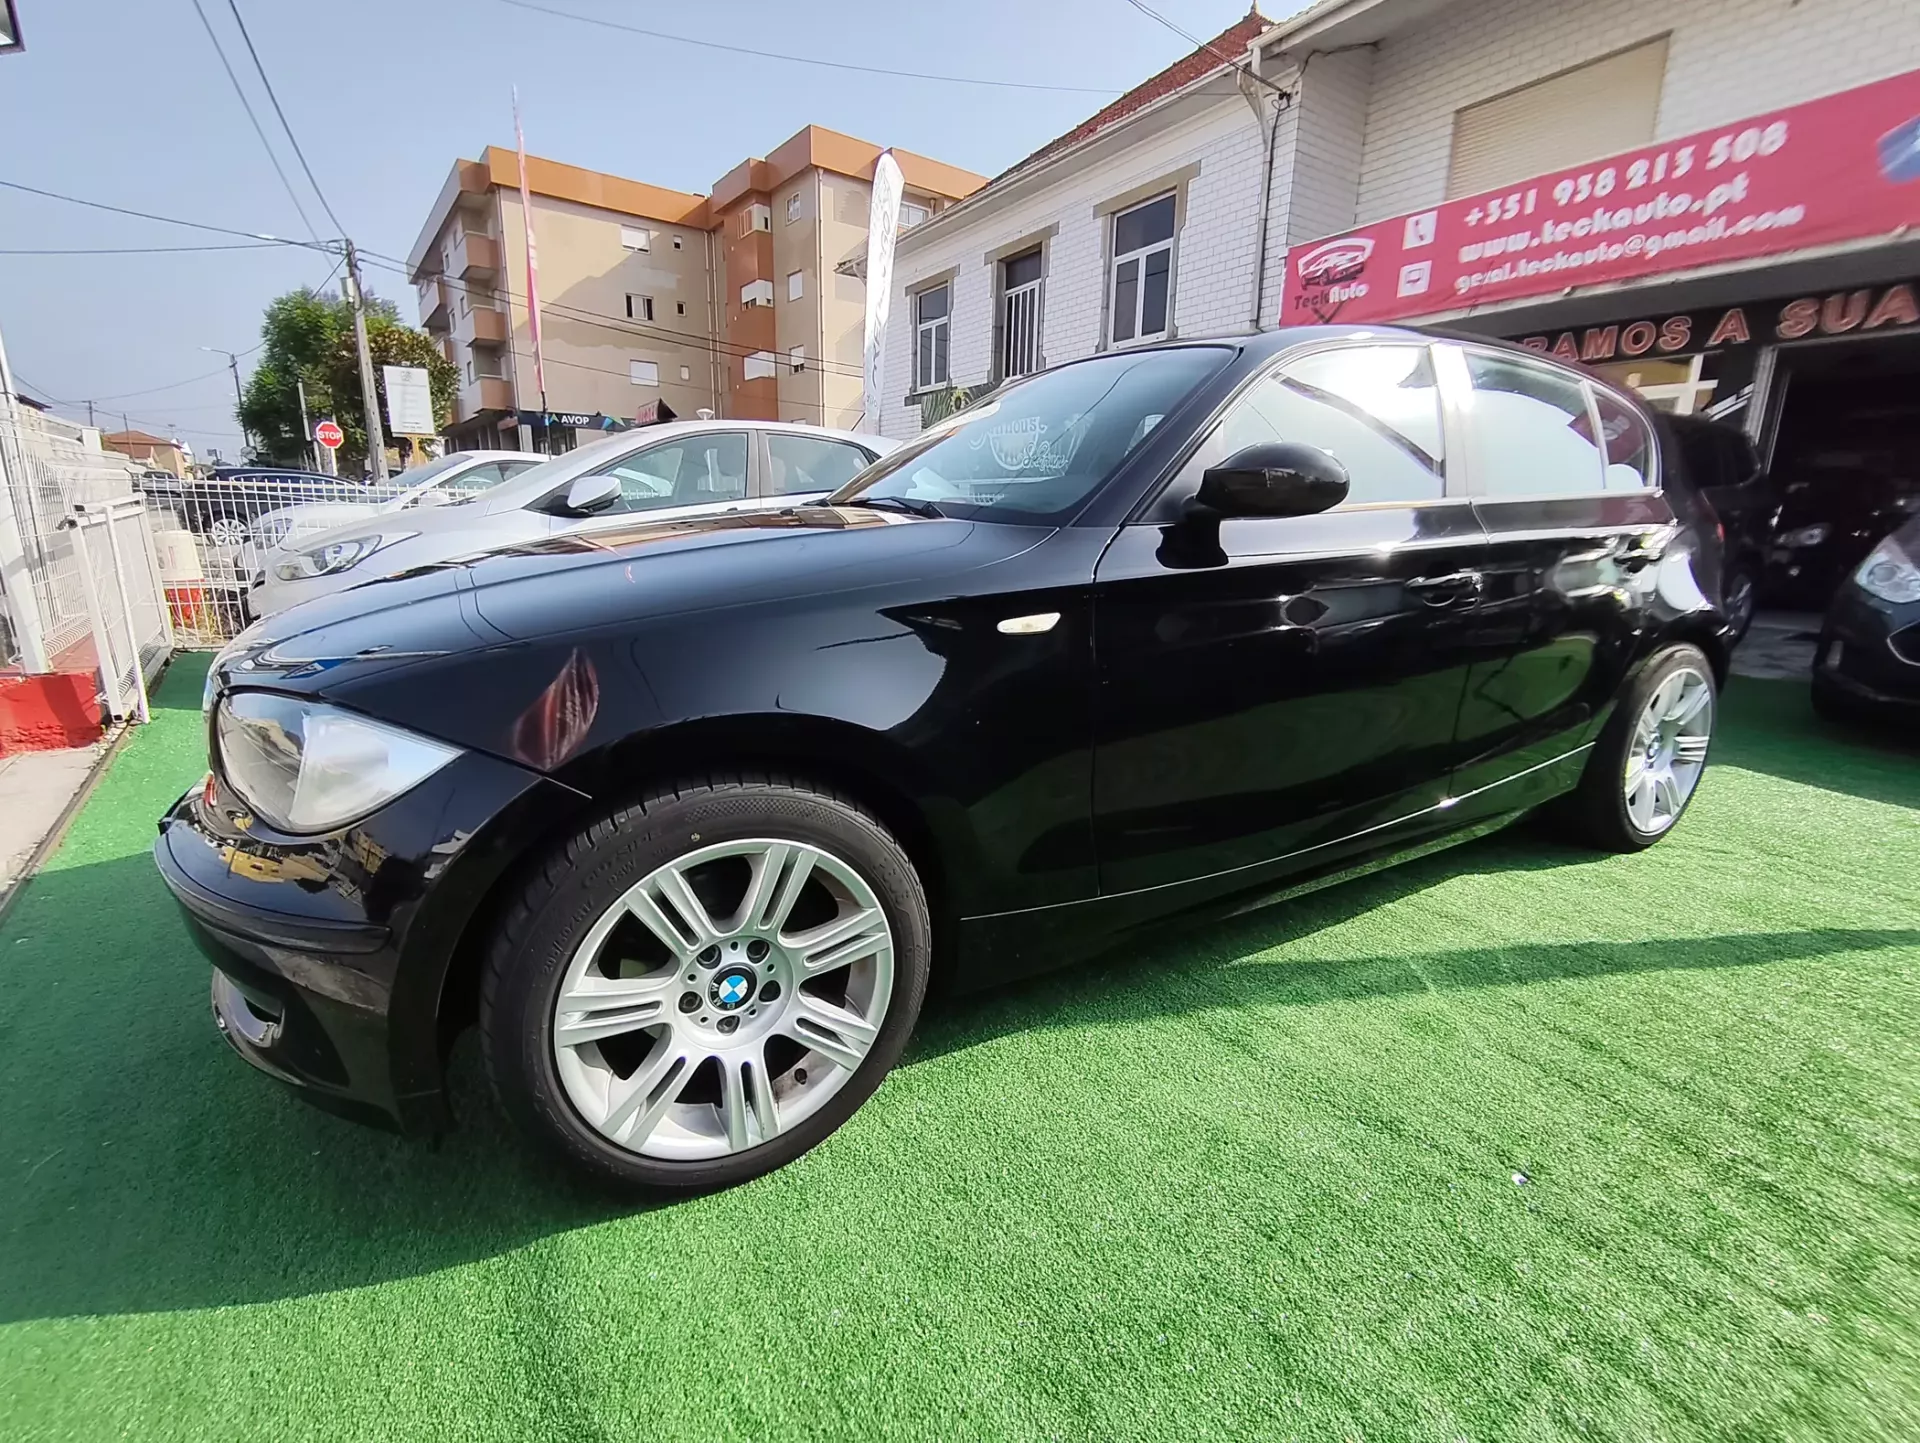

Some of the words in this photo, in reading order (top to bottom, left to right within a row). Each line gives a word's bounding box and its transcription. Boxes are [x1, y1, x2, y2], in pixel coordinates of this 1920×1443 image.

[1463, 187, 1538, 227] +351
[1552, 167, 1617, 207] 938
[1624, 145, 1697, 191] 213
[1705, 120, 1789, 171] 508
[1458, 171, 1750, 264] www.teckauto.pt
[1704, 307, 1751, 347] A
[1774, 283, 1920, 339] SUA
[318, 430, 342, 440] STOP
[560, 414, 590, 425] AVOP
[710, 981, 736, 1010] BMW
